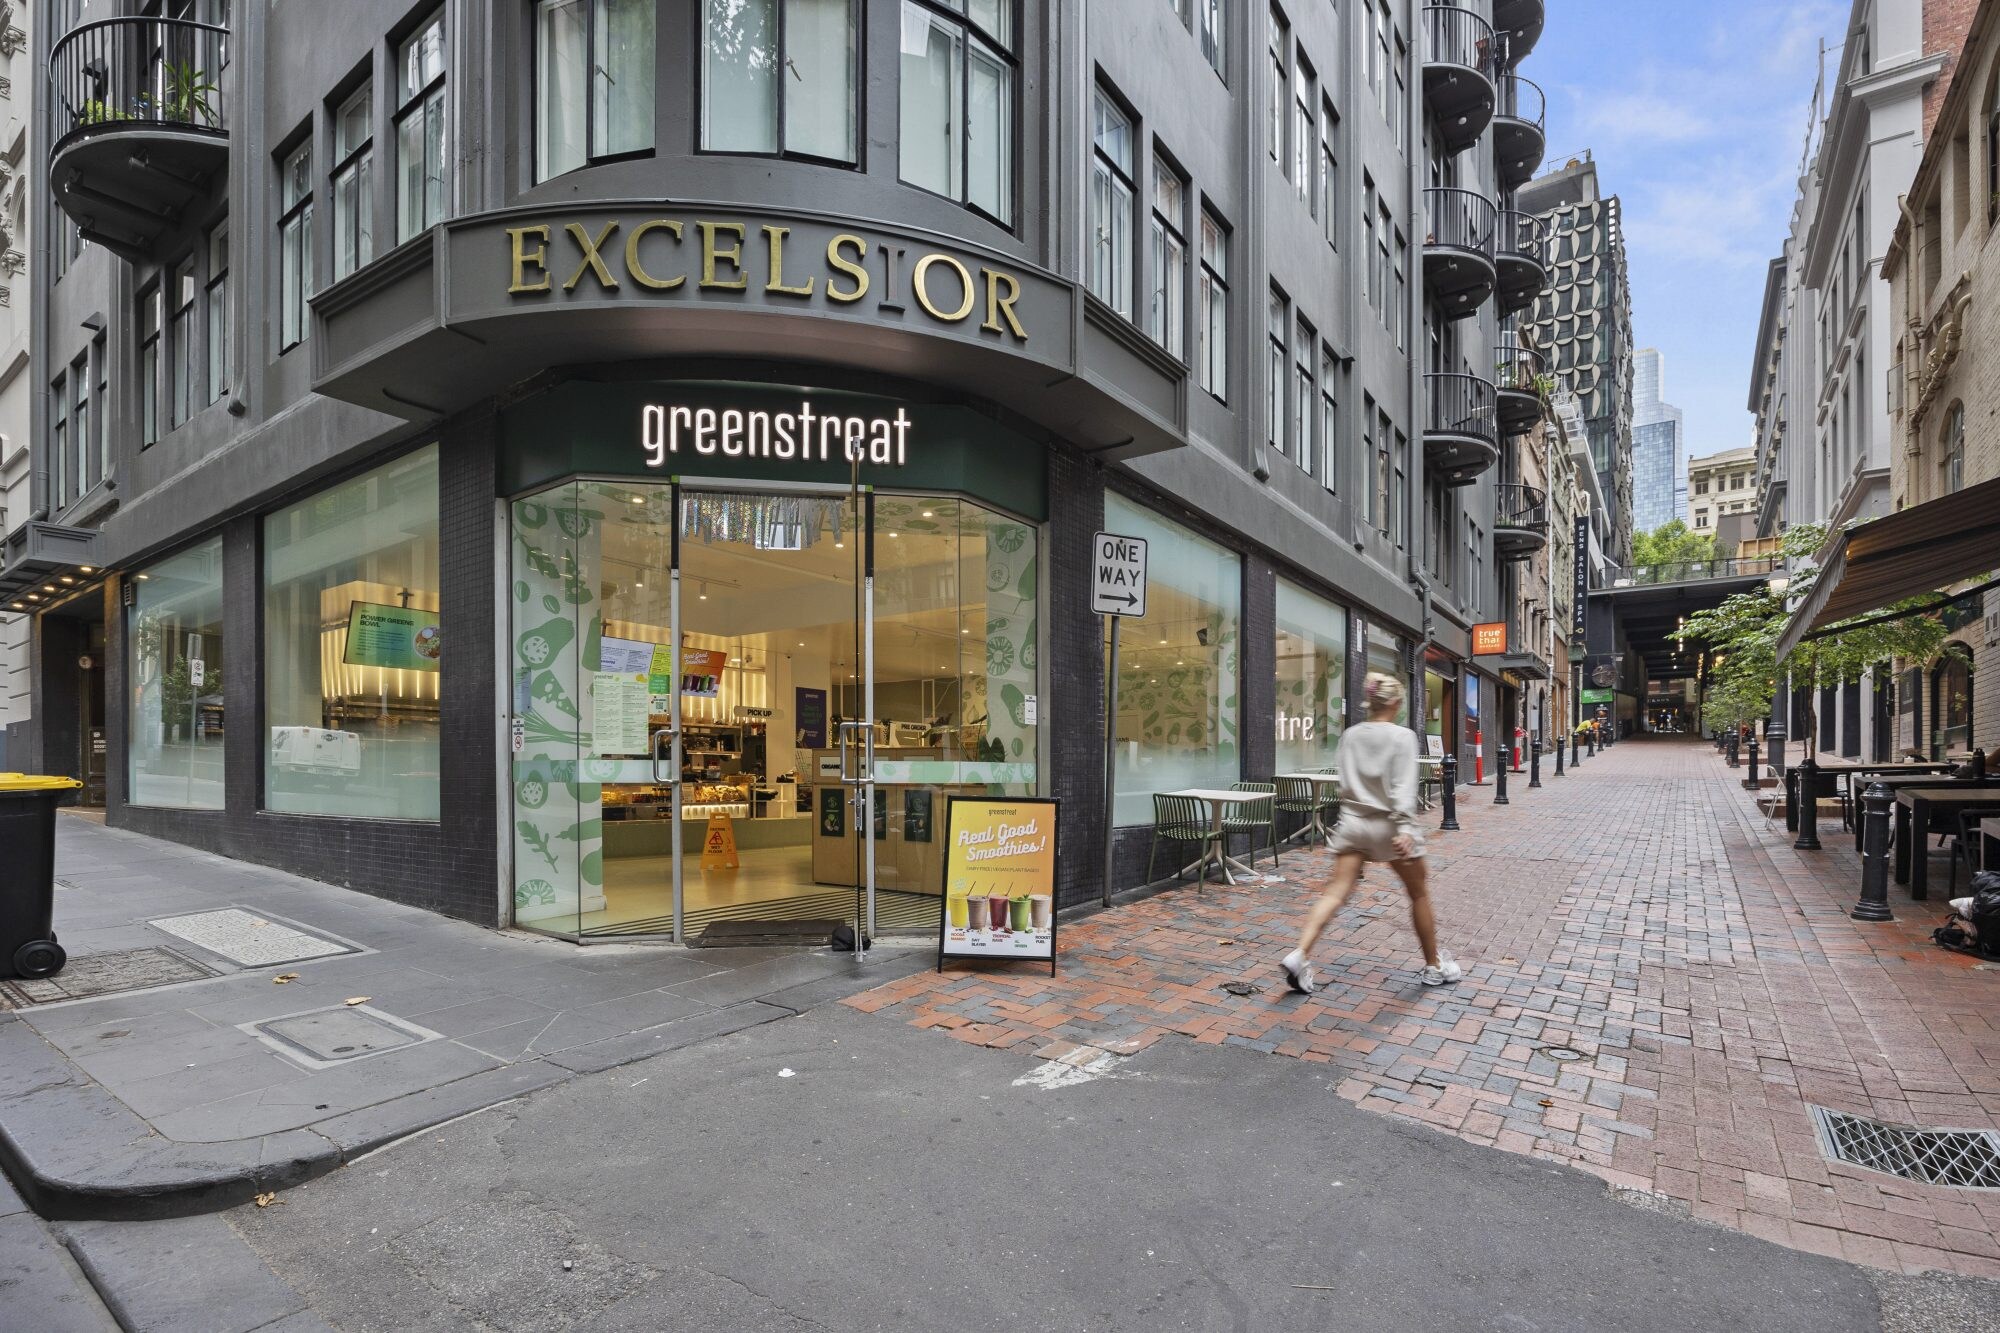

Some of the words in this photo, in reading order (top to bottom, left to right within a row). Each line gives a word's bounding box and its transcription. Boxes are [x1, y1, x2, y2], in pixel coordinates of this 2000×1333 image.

[506, 219, 1028, 341] EXCELSIOR
[642, 401, 912, 467] greenstreat
[1103, 541, 1139, 563] ONE
[1099, 565, 1141, 587] WAY
[360, 614, 387, 623] POWER
[387, 617, 415, 626] GREENS
[1479, 630, 1501, 638] true
[747, 708, 763, 717] PICK
[958, 826, 995, 847] Real
[997, 818, 1038, 845] Good
[966, 836, 1046, 862] Smoothies!
